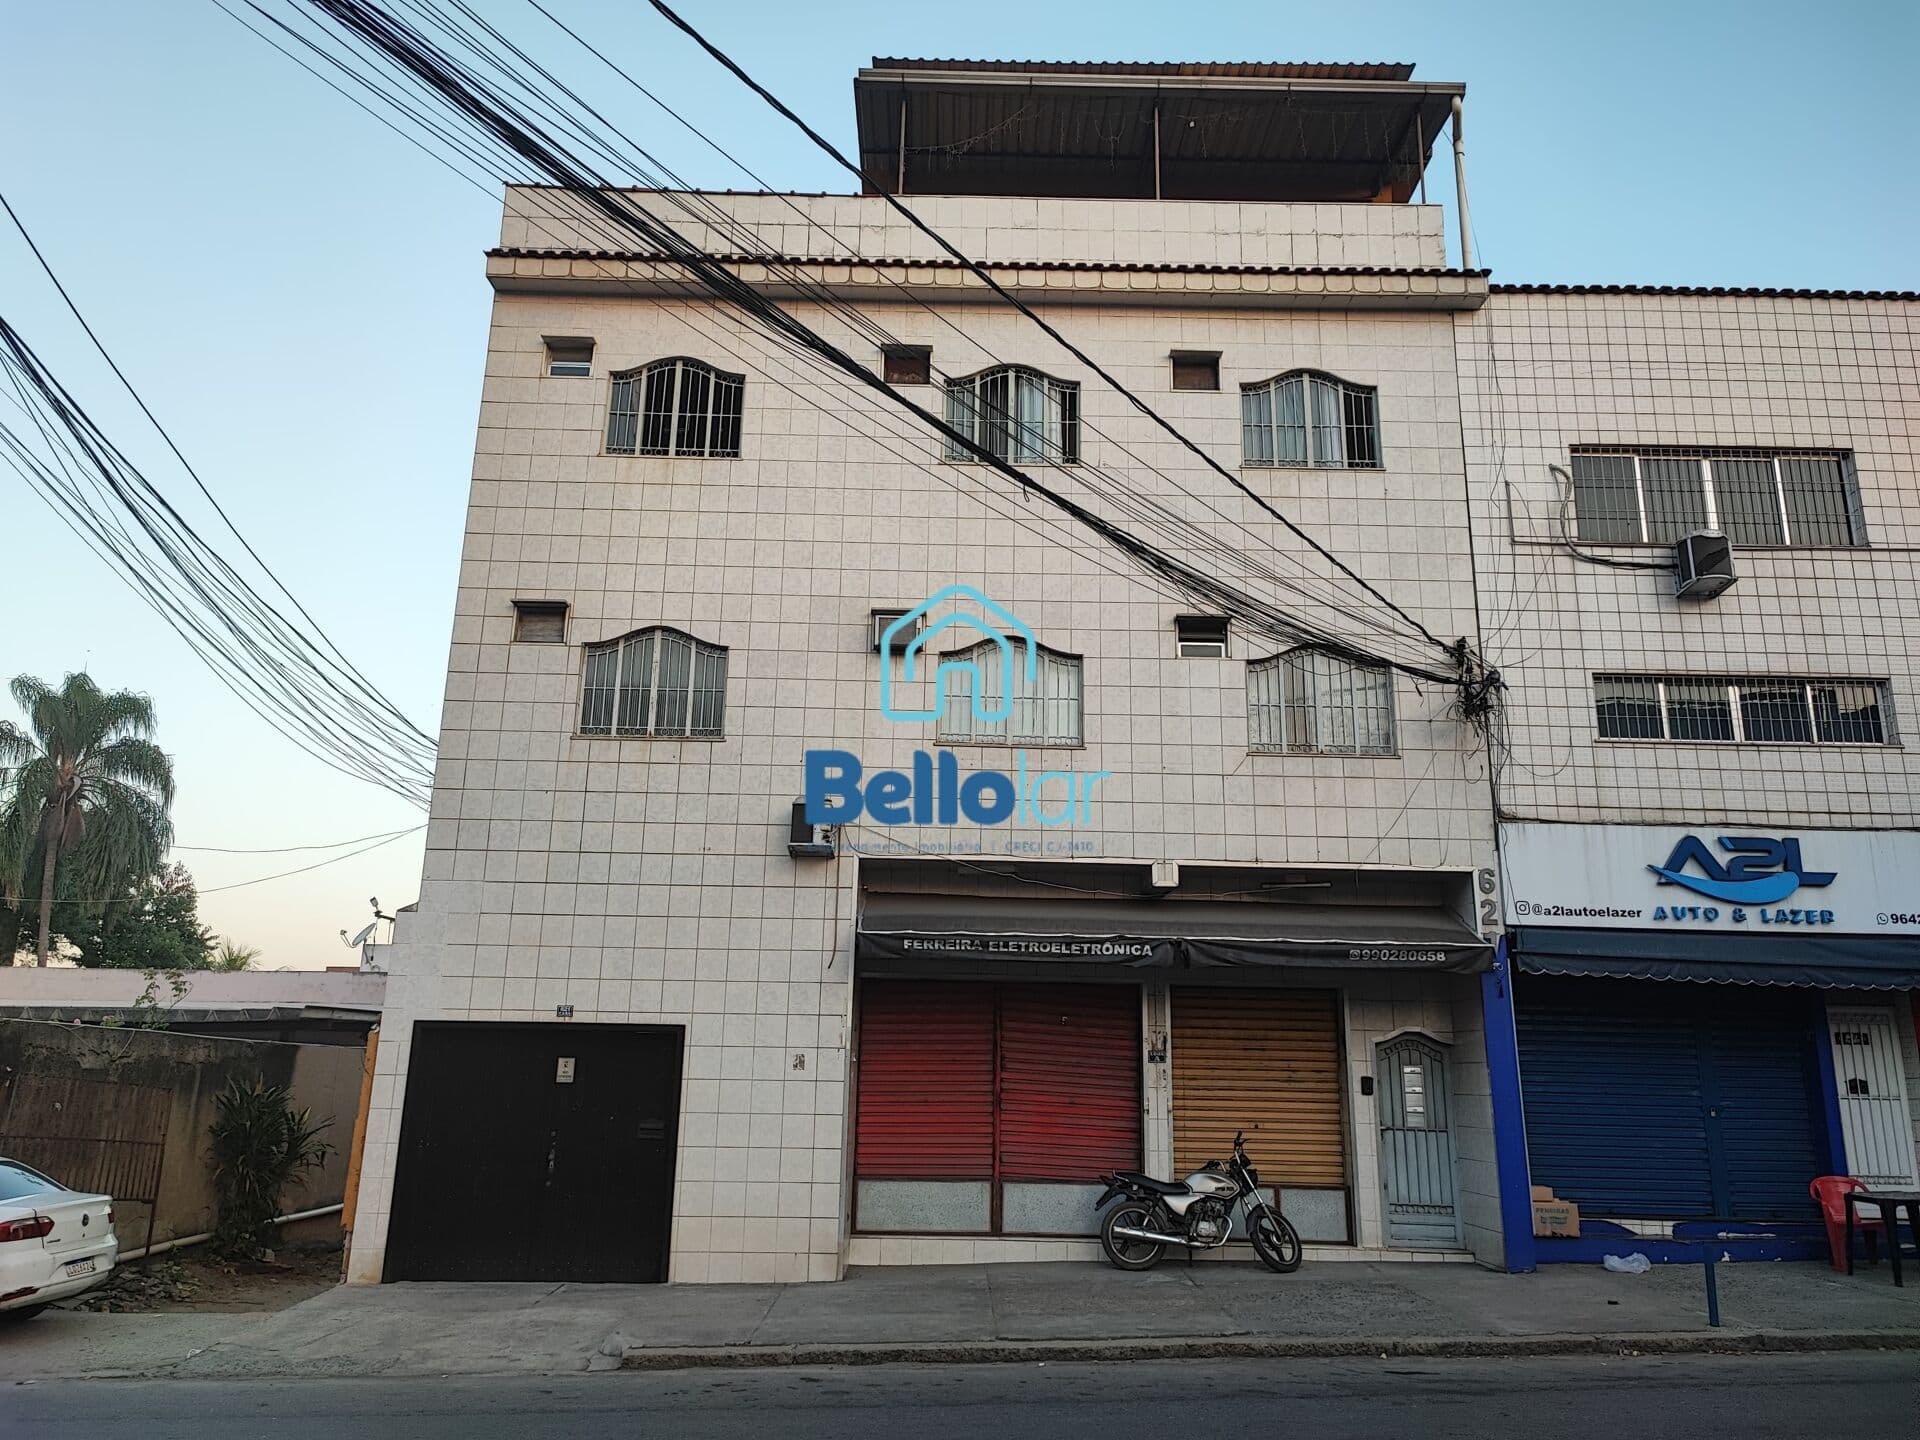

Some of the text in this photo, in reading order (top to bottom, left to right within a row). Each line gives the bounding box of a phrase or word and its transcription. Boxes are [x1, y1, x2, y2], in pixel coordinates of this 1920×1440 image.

[1653, 905, 1835, 925] AUTO & LAZER
[903, 938, 1153, 957] FERREIRA ELETROELETRÔNICA
